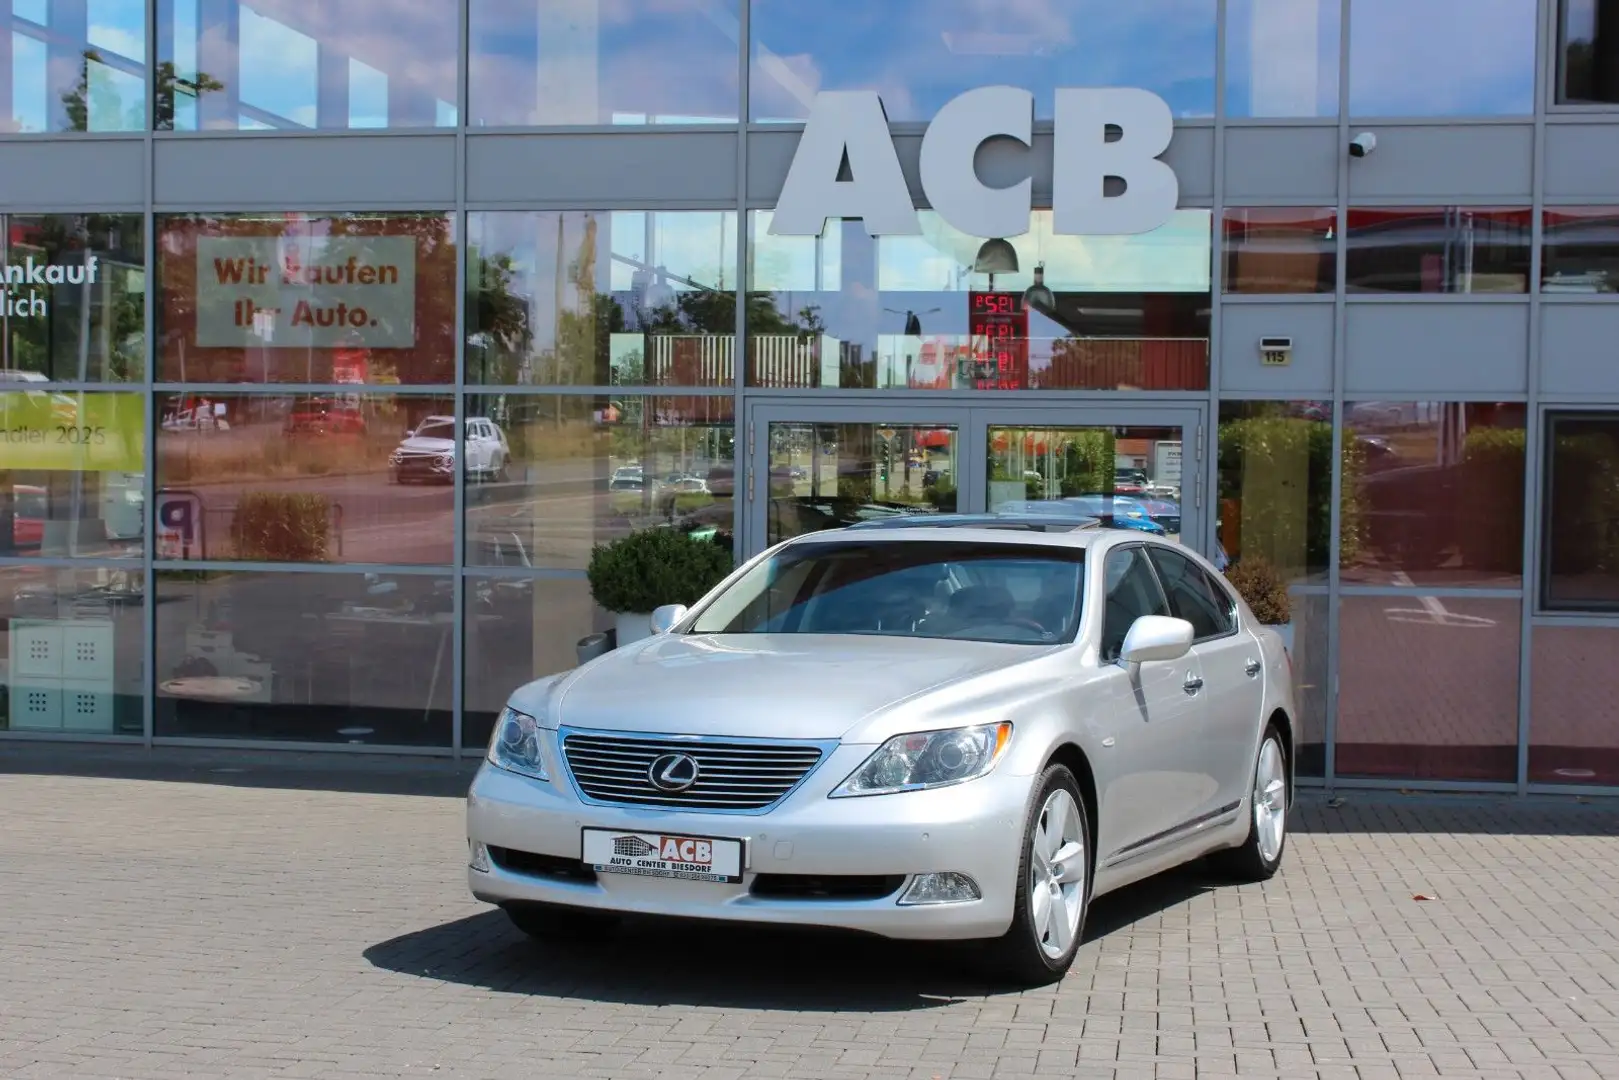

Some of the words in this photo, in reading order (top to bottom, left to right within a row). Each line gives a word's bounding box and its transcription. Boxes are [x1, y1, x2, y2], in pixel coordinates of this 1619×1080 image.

[767, 85, 1179, 238] ACB
[213, 257, 271, 285] Wir
[283, 255, 398, 285] kaufen
[290, 299, 378, 328] Auto.
[1264, 350, 1286, 363] 115
[55, 425, 106, 446] 2025
[661, 839, 712, 863] ACB
[610, 857, 632, 866] AUTO
[637, 860, 666, 869] CENTER
[671, 863, 712, 873] BIESDORF
